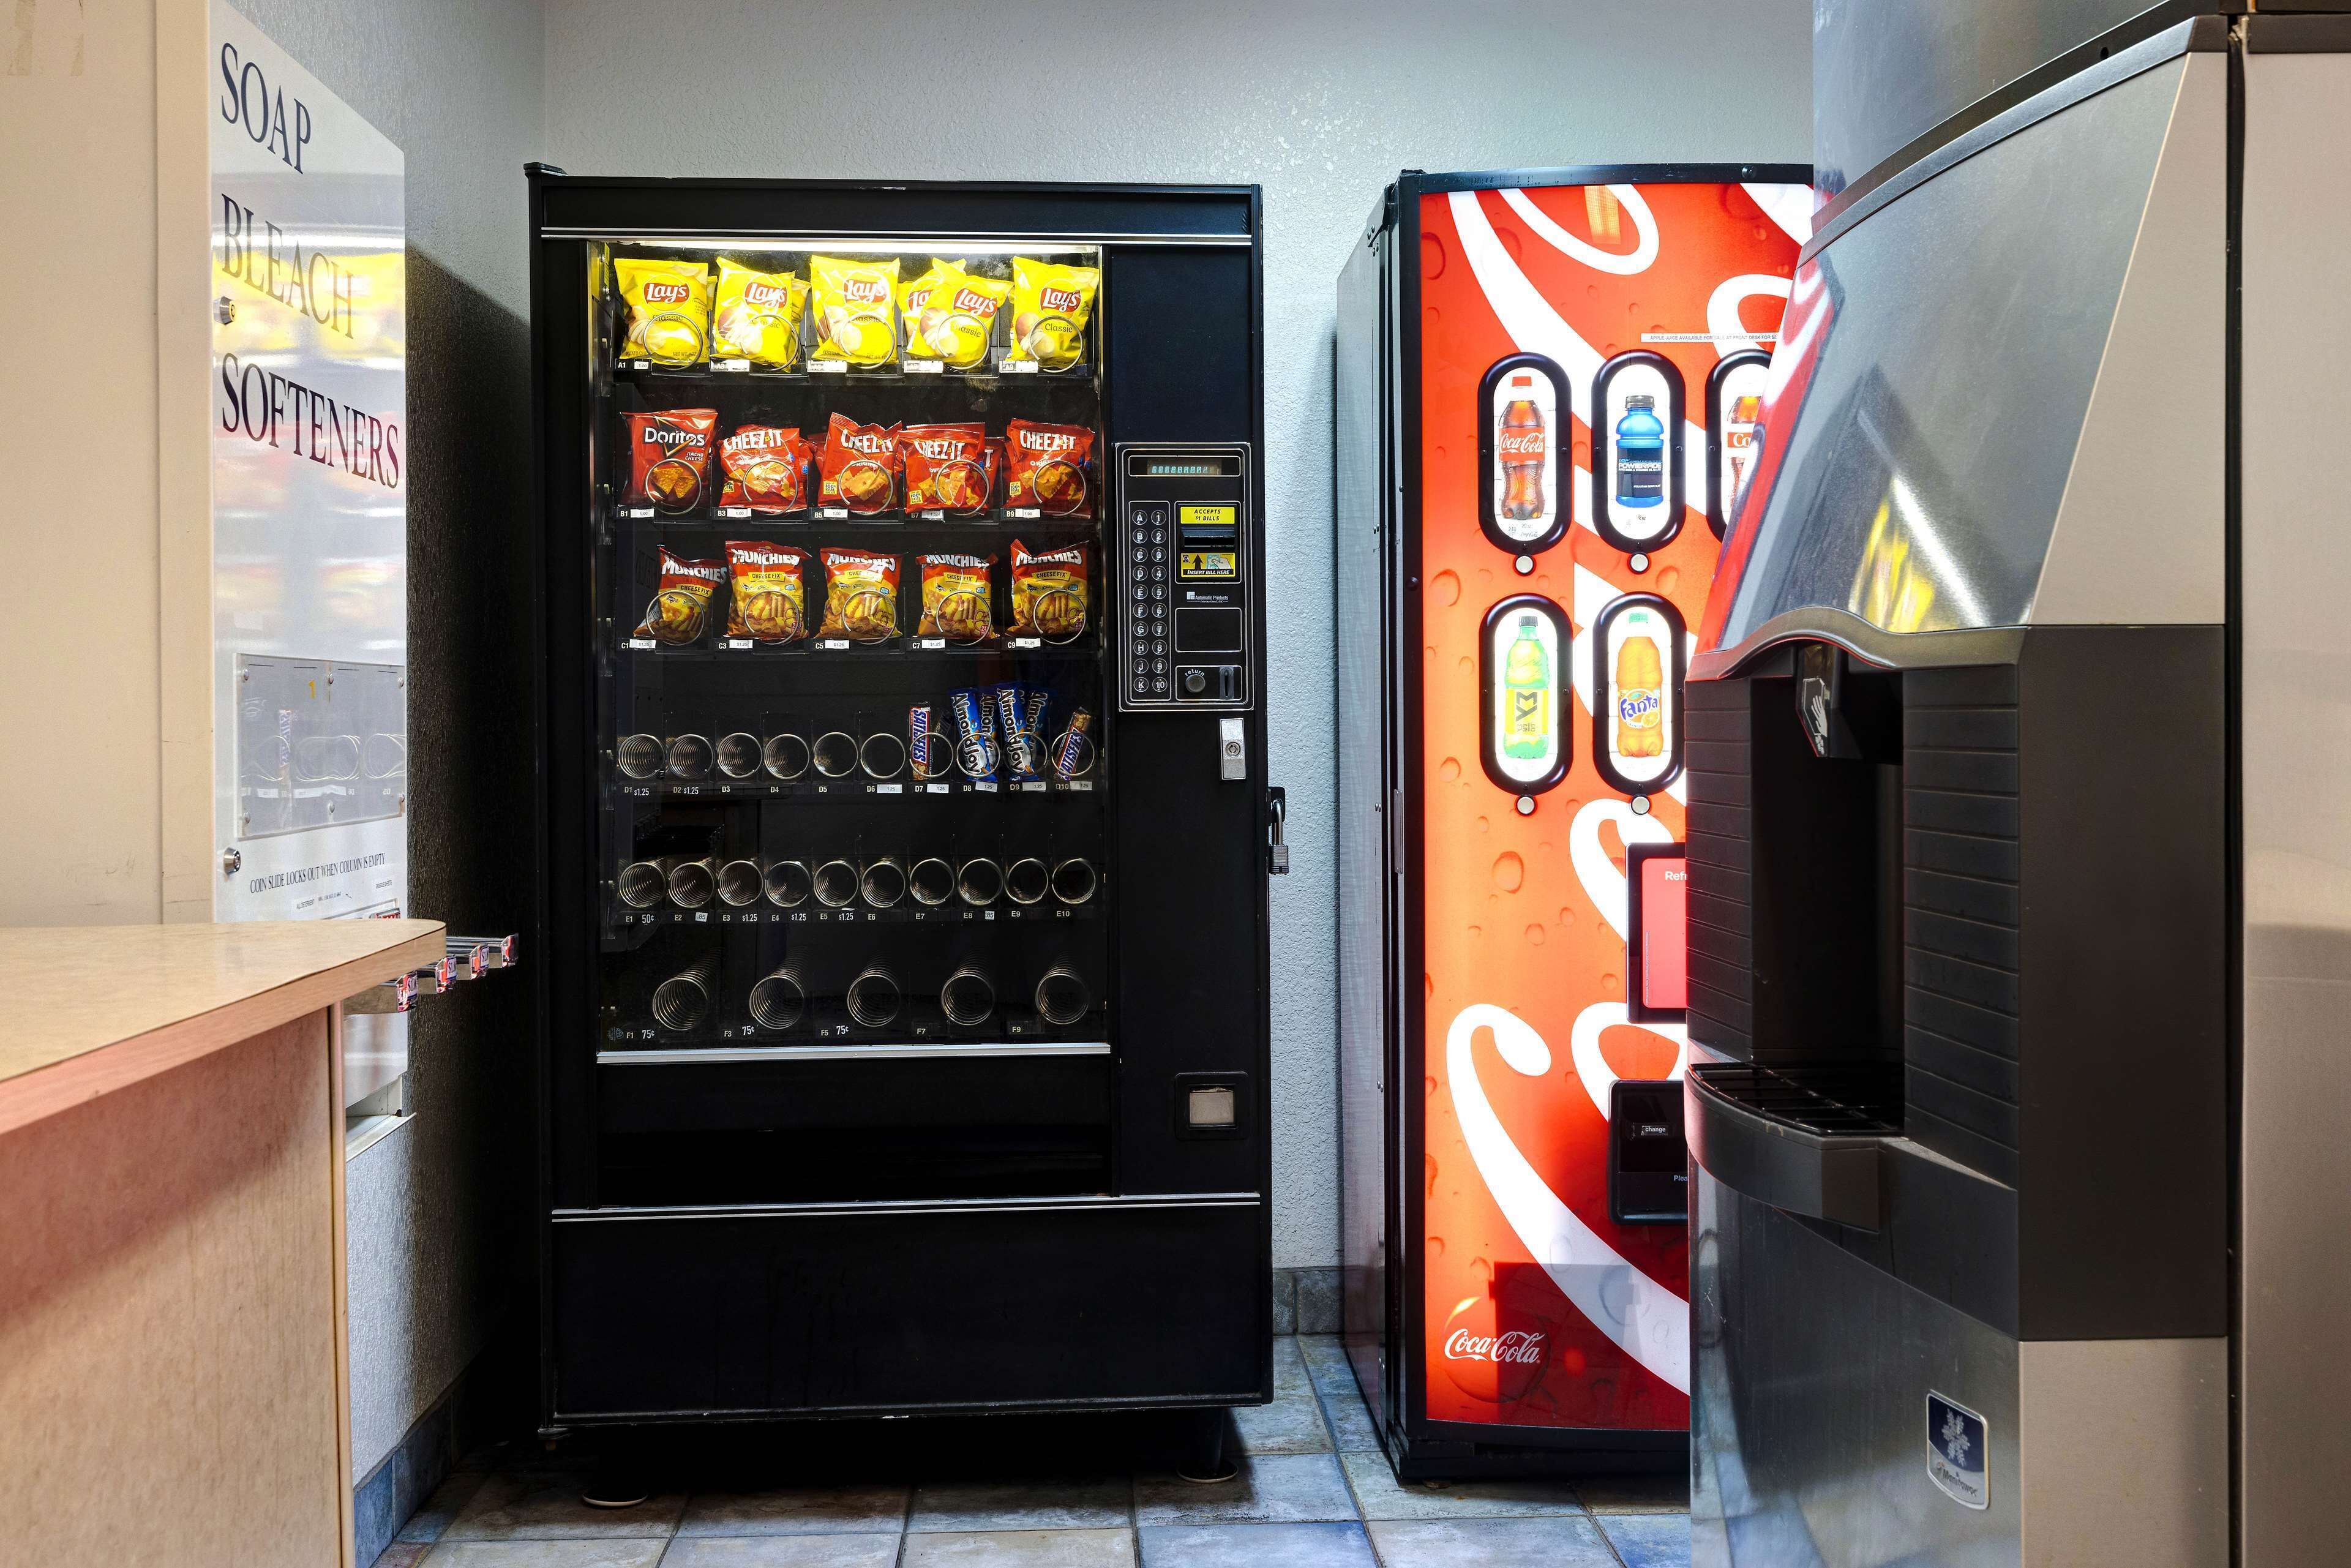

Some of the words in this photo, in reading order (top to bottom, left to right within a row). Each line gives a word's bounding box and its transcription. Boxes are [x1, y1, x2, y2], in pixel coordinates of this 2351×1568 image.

[221, 43, 312, 174] SOAP
[222, 193, 354, 340] BLEACH
[647, 283, 687, 303] Lay's
[956, 289, 997, 315] Lay's
[1043, 288, 1081, 312] Lay's
[1045, 323, 1073, 333] Classic
[222, 353, 399, 489] SOFTENERS
[645, 427, 705, 446] Doritos
[1500, 432, 1543, 454] Coca-Cola
[731, 549, 800, 566] MUNCHIES
[926, 554, 990, 568] MUNCHIES
[1016, 550, 1082, 566] MUNCHIES
[662, 554, 727, 584] MUNCHIES
[1620, 695, 1658, 721] Fanta
[913, 708, 927, 763] SATISFIES
[250, 877, 267, 893] COIN
[268, 873, 285, 890] SLIDE
[286, 869, 306, 885] LOCKS
[307, 866, 320, 881] OUT
[321, 862, 339, 877] WHEN
[339, 857, 362, 874] COLUMN
[363, 857, 368, 869] IS
[369, 852, 385, 868] EMPTY
[642, 914, 654, 924] 50¢
[642, 1029, 654, 1039] 75¢
[742, 1026, 755, 1035] 75¢
[836, 1025, 849, 1035] 75¢
[1444, 1328, 1546, 1364] Coca-Cola
